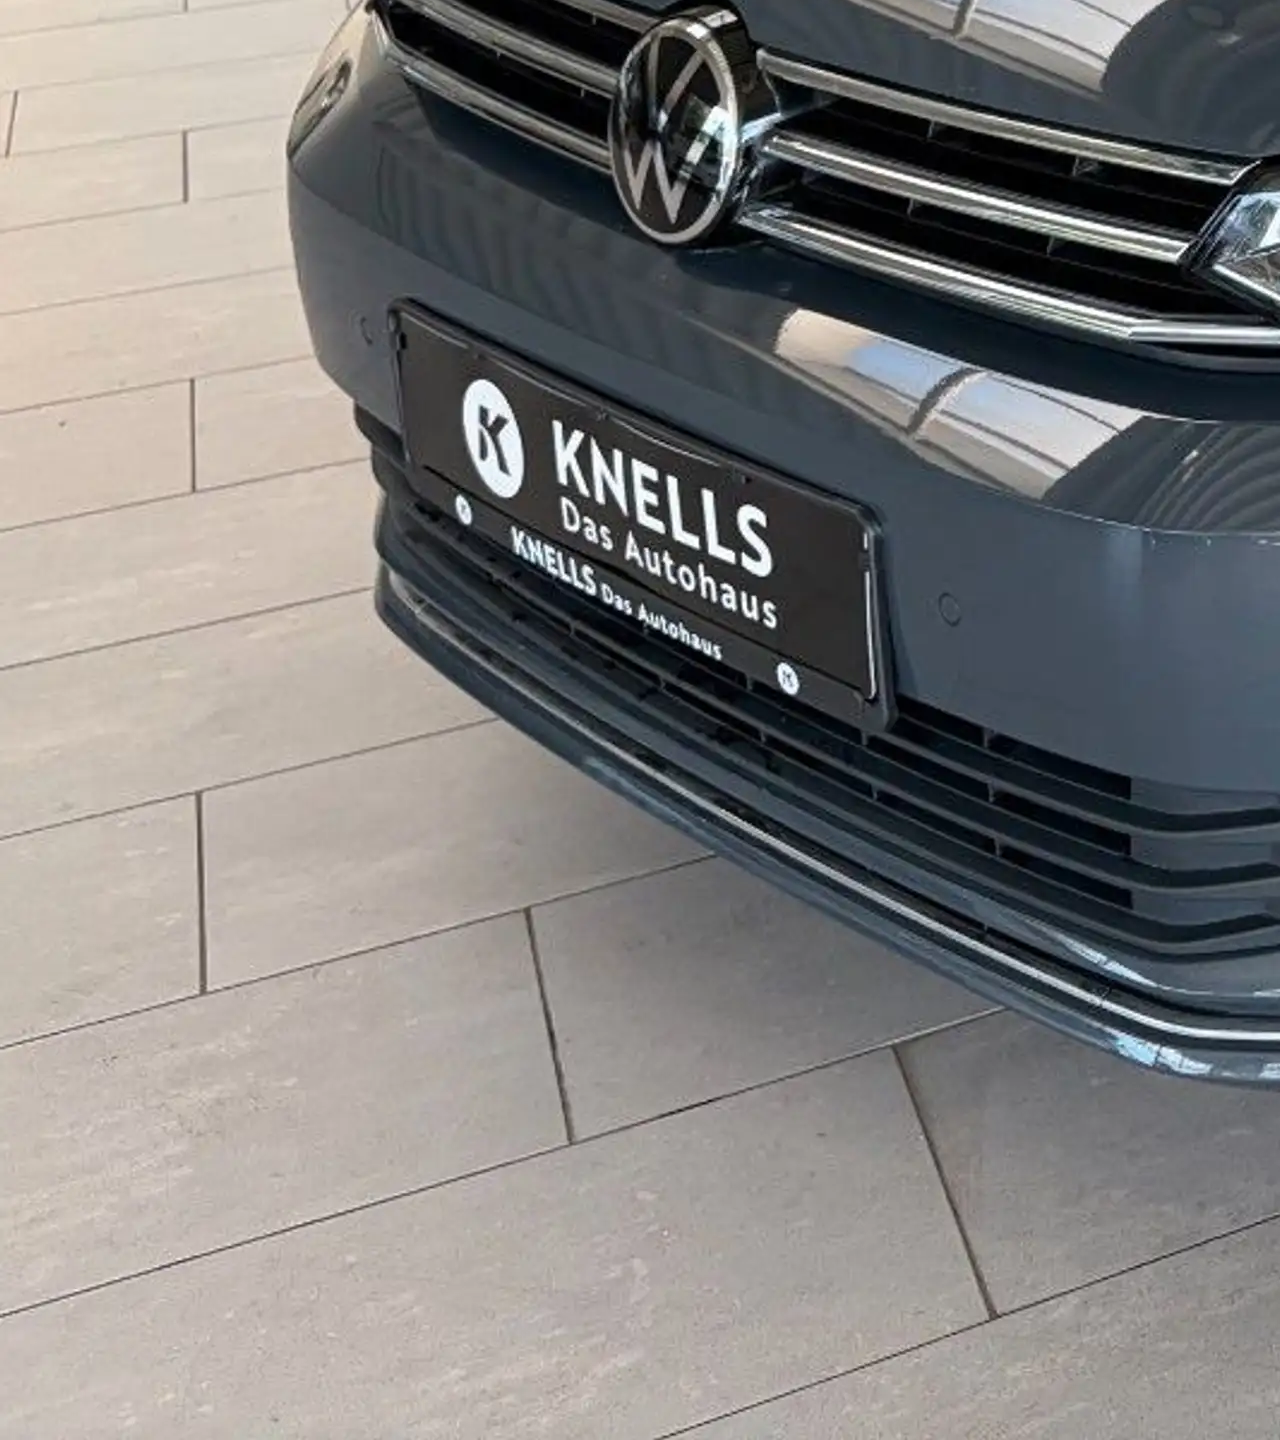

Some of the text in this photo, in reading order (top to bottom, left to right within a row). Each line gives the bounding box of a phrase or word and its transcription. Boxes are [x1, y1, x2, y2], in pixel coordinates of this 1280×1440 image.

[552, 419, 773, 578] KNELLS
[561, 496, 778, 629] Das Autohaus
[511, 526, 723, 661] KNELLS Das Autohaus
